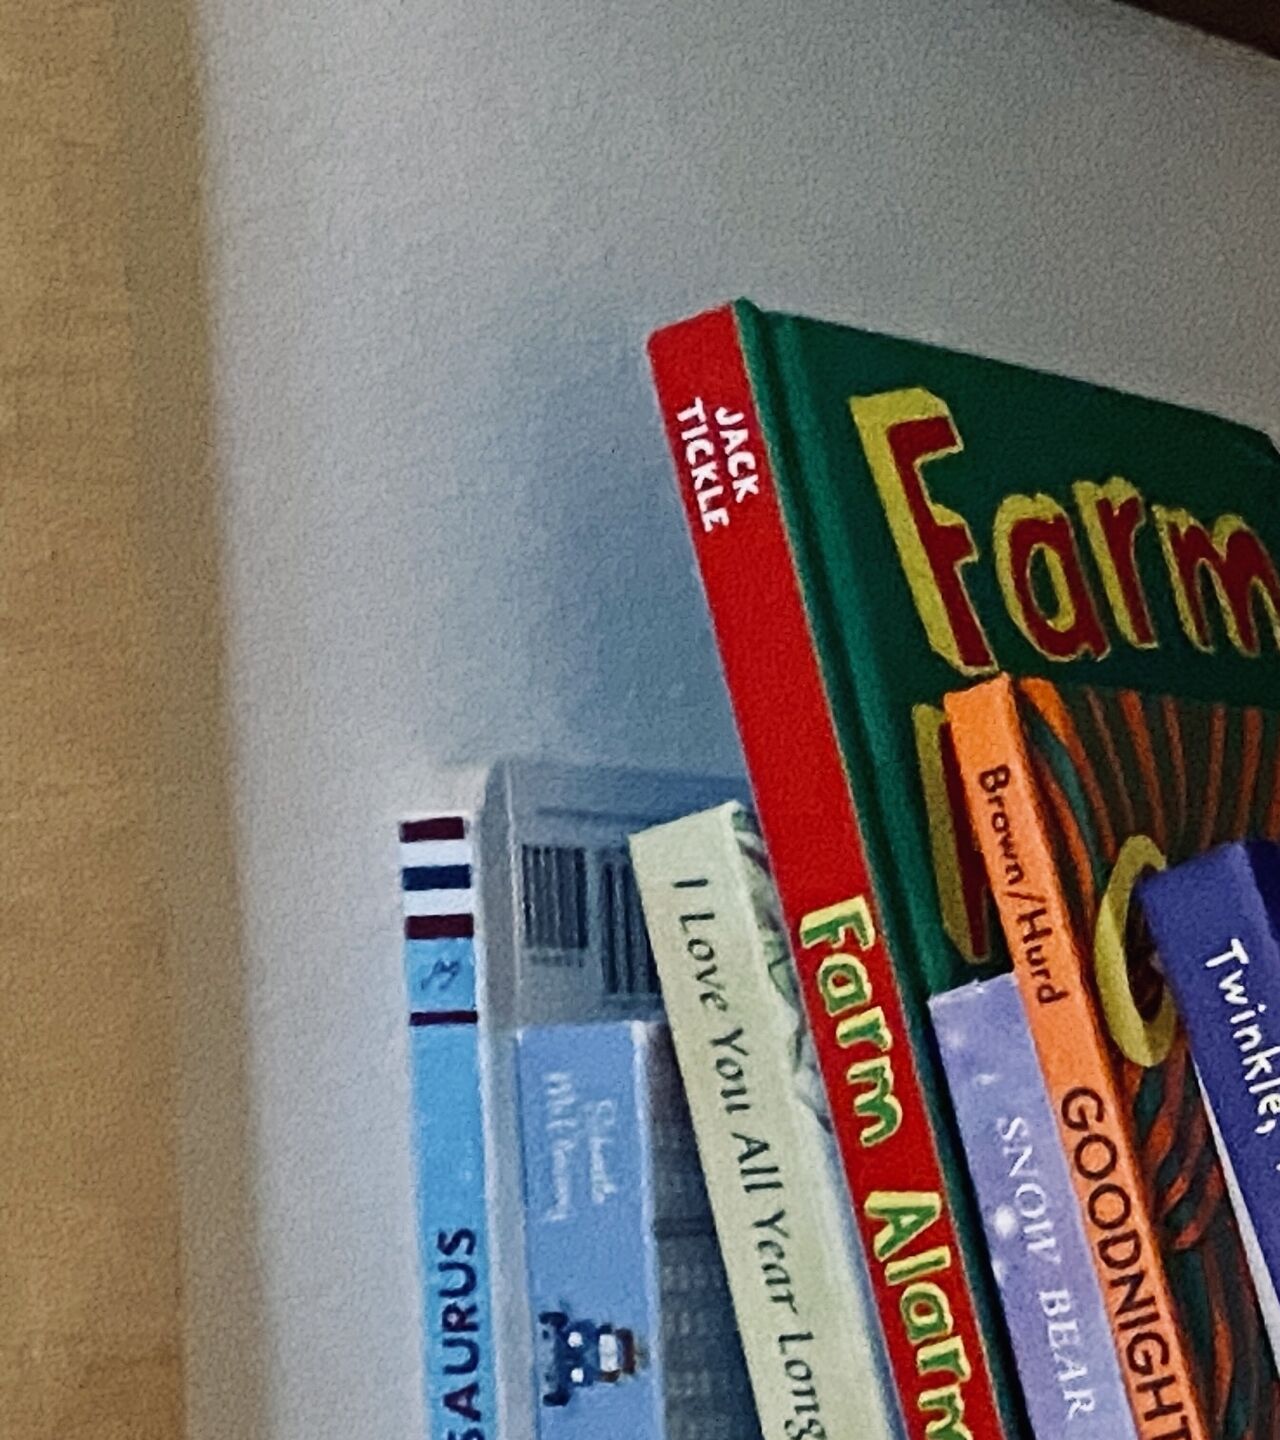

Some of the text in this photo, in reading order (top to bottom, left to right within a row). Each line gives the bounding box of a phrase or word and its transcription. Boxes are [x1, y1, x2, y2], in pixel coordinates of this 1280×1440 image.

[676, 397, 730, 532] TICKLE
[714, 405, 759, 504] JACK
[674, 878, 708, 889] I
[979, 765, 1067, 1006] Brown/Hurd
[678, 908, 729, 1013] Love
[709, 1028, 750, 1117] You
[800, 896, 905, 1147] Farm
[731, 1131, 784, 1195] All
[748, 1208, 800, 1315] Year
[997, 1116, 1097, 1421] SNOW BEAR
